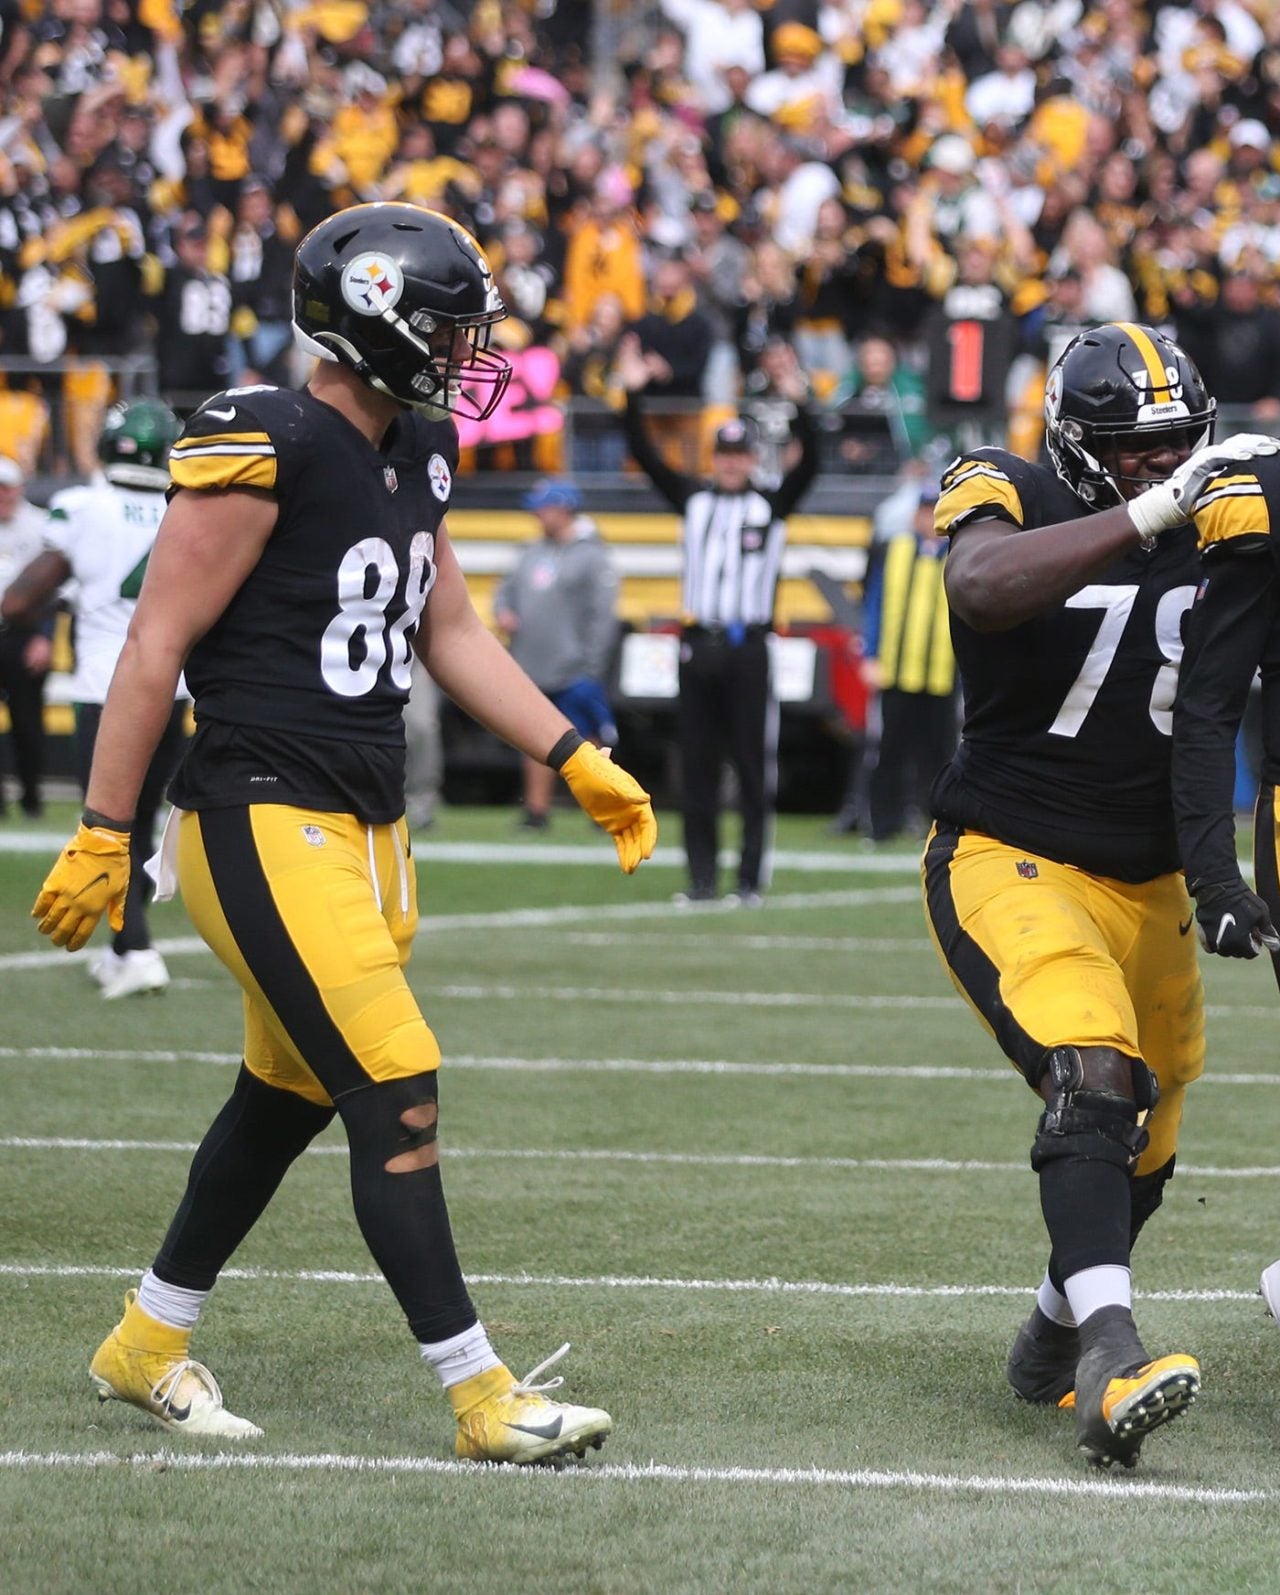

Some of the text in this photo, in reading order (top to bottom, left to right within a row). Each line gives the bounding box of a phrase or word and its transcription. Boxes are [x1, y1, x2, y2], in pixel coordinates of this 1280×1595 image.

[1131, 366, 1183, 406] 78
[1151, 405, 1177, 415] Steelers
[321, 531, 437, 696] 88
